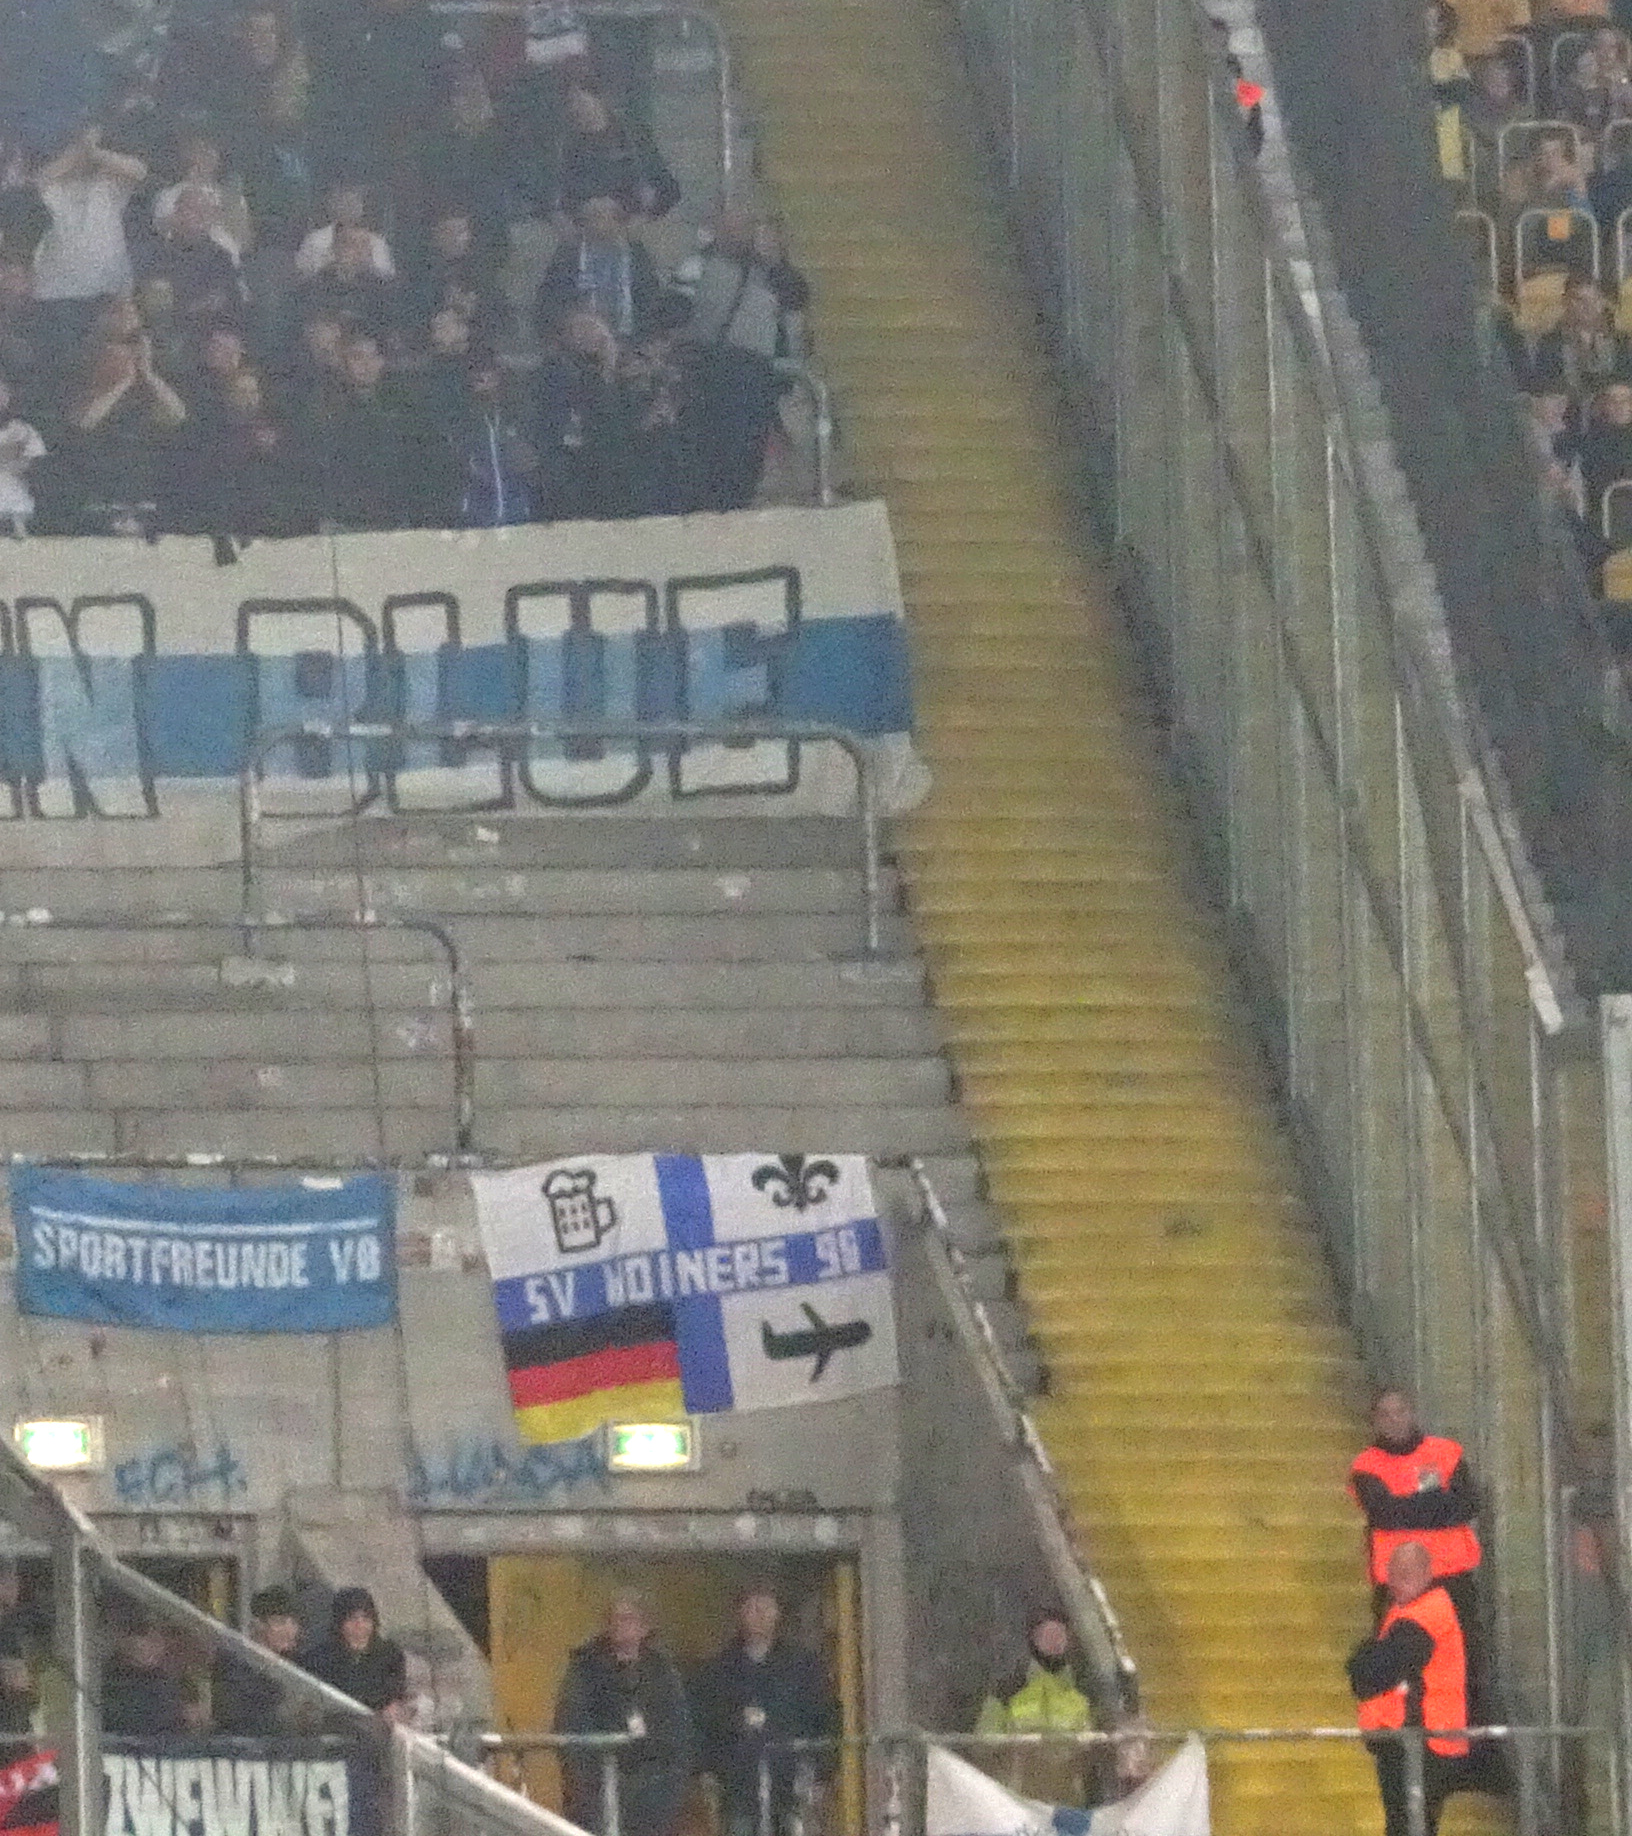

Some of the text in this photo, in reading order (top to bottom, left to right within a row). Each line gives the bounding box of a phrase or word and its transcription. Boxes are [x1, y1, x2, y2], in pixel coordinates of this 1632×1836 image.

[236, 564, 804, 819] BLUE
[30, 1221, 310, 1291] SPORTFREUNDE
[523, 1271, 576, 1325] SV
